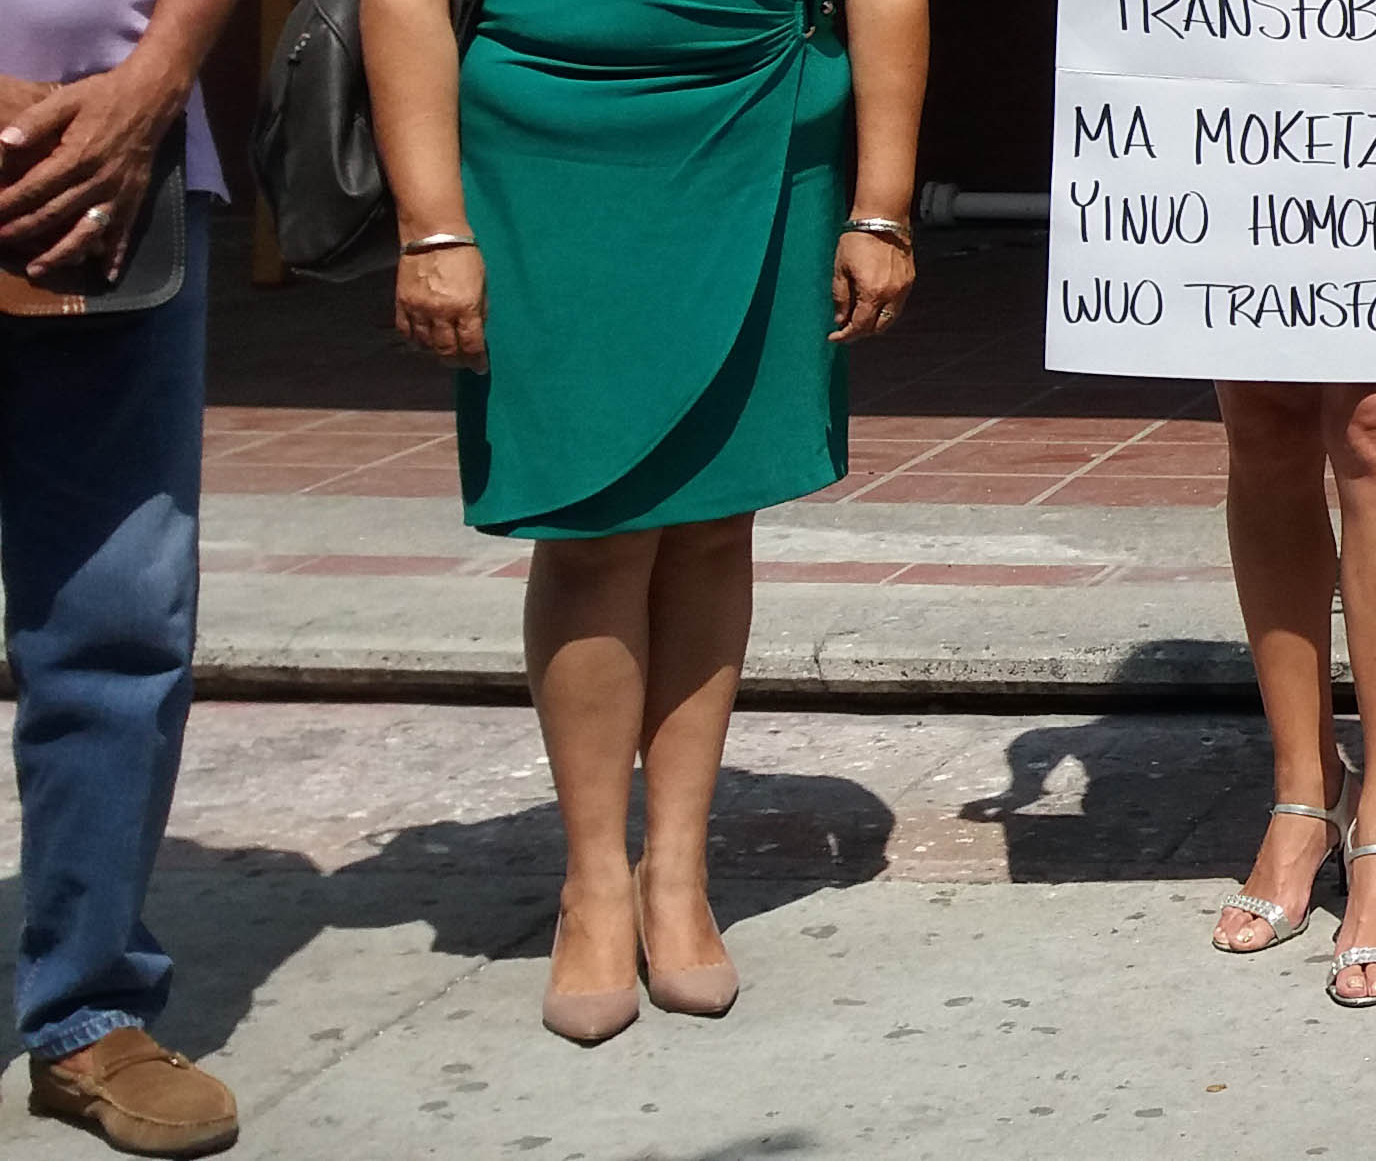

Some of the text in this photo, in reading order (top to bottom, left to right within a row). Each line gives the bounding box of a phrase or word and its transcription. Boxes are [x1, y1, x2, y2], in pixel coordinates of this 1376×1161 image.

[1074, 103, 1157, 159] MA
[1070, 180, 1208, 245] YINUO
[1063, 279, 1162, 325] WUO
